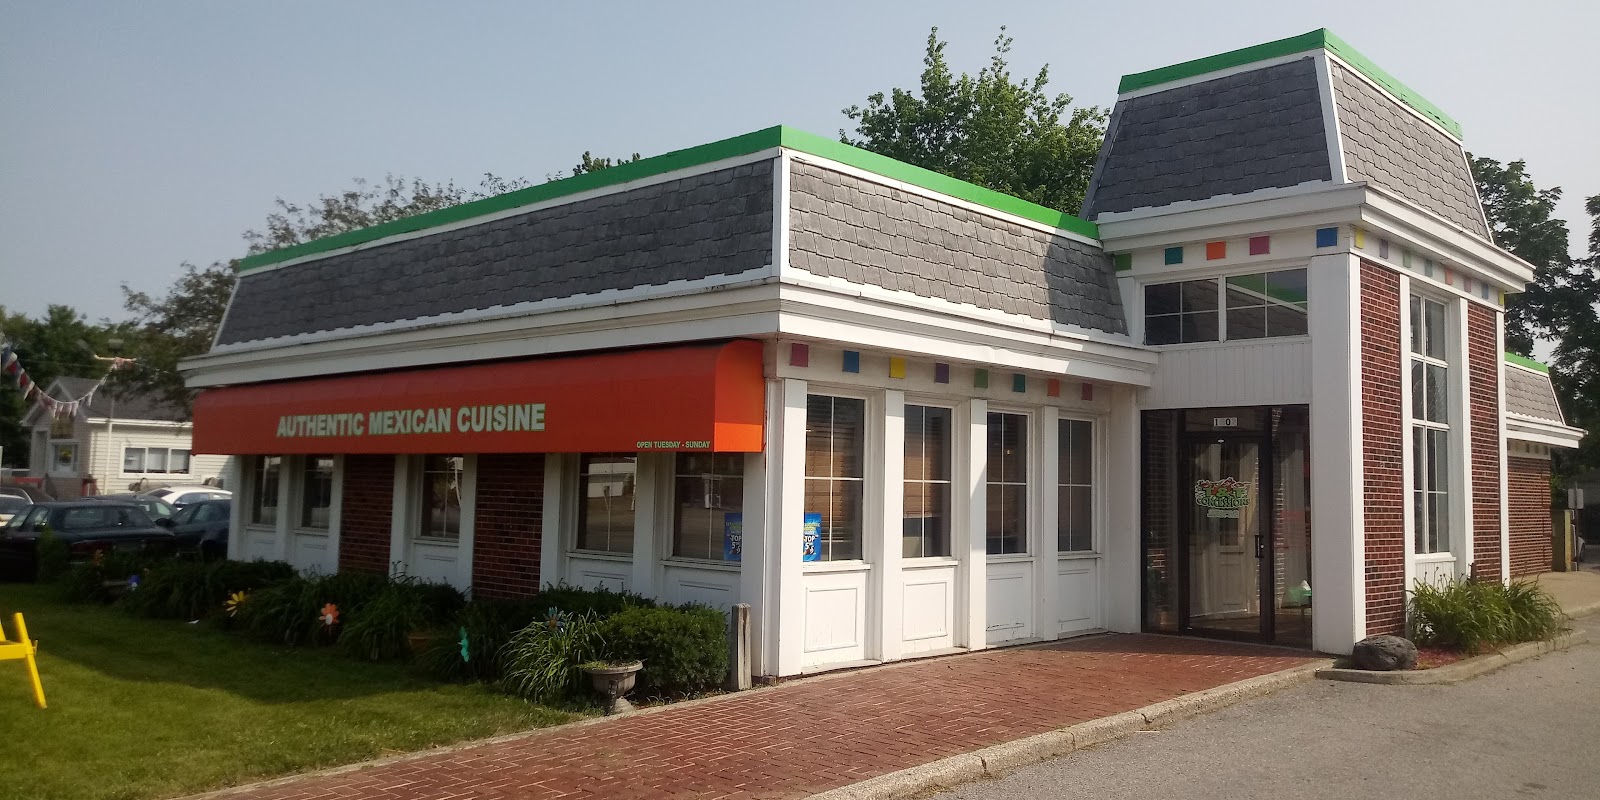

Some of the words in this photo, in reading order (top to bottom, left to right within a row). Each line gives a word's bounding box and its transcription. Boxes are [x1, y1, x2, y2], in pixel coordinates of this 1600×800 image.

[276, 412, 365, 438] AUTHENTIC
[368, 407, 452, 435] MEXICAN
[457, 403, 546, 433] CUISINE
[636, 441, 653, 449] OPEN
[654, 441, 681, 449] TUESDAY
[685, 440, 711, 449] SUNDAY
